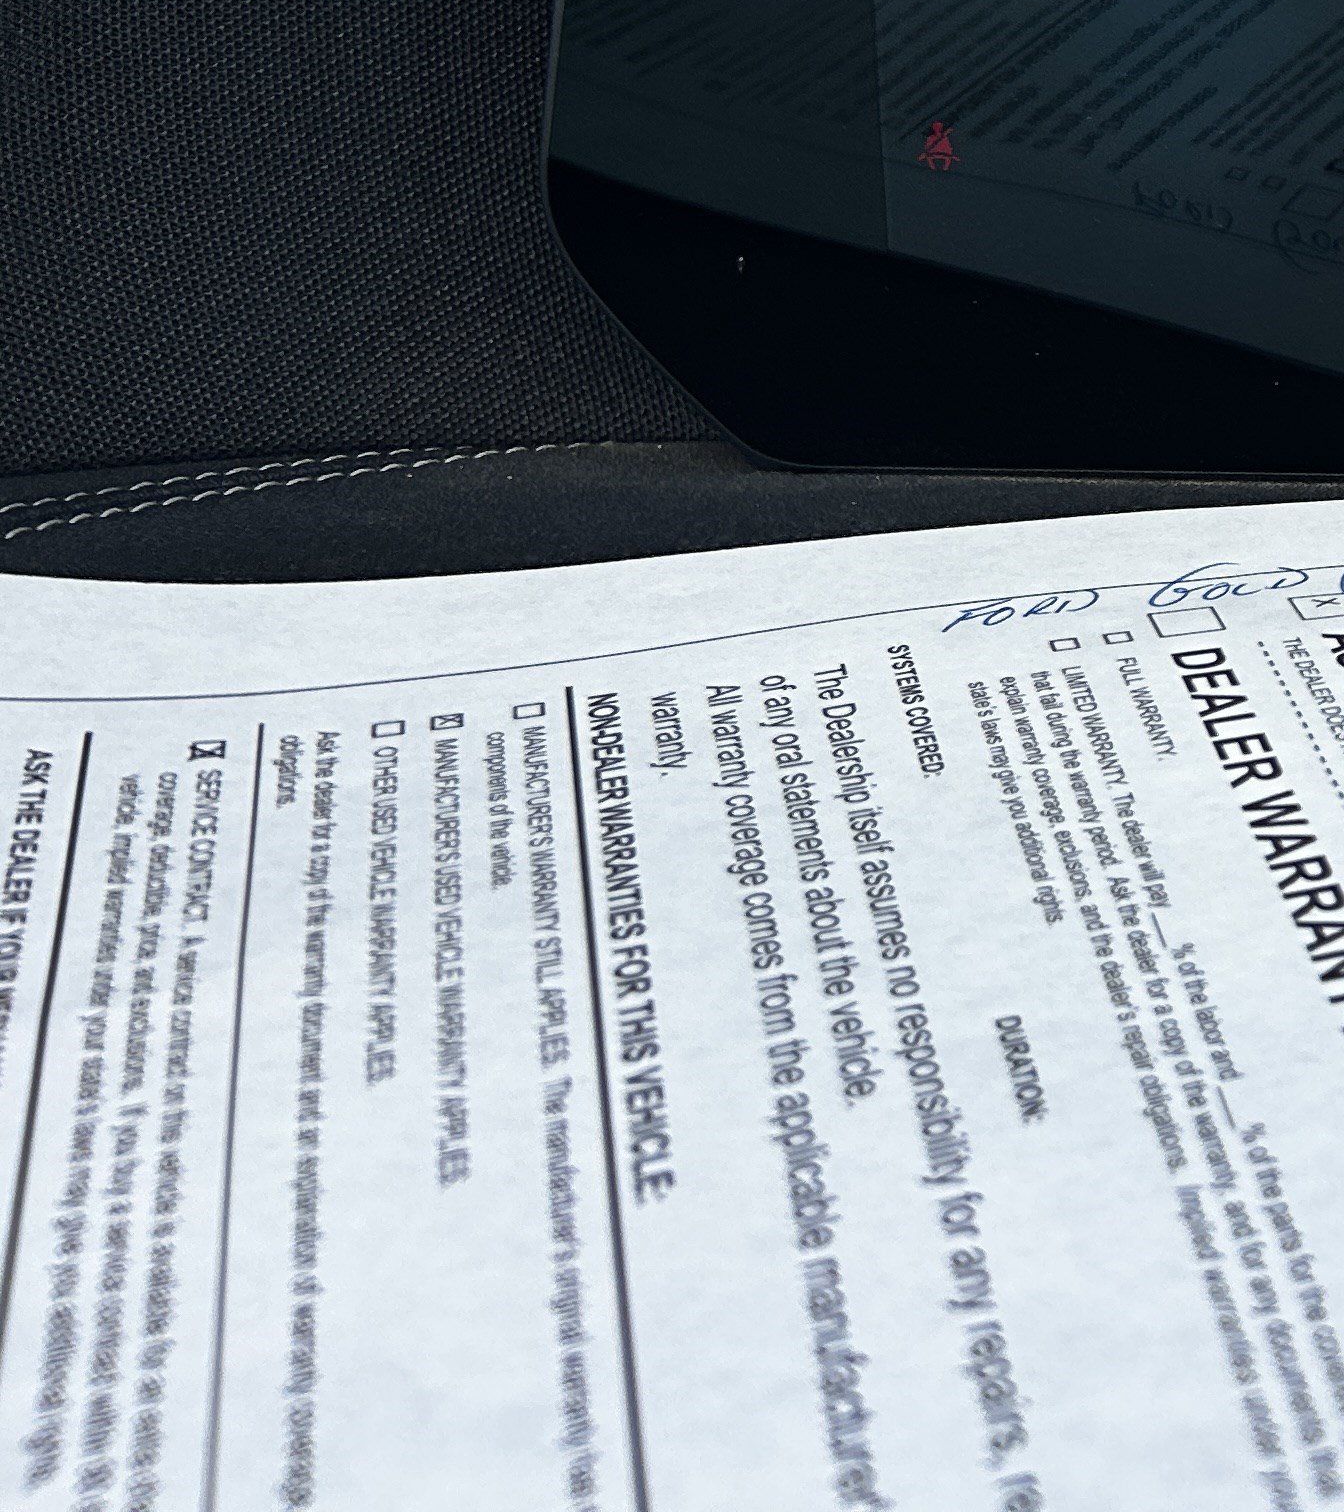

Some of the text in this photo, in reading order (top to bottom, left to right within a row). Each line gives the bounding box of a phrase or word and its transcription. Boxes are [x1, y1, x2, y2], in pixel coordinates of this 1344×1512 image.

[1281, 635, 1310, 660] THE
[812, 662, 849, 701] The
[886, 643, 945, 778] SYSTEMS COVERED:
[966, 680, 997, 718] state's
[1029, 669, 1056, 693] that
[1115, 656, 1178, 762] FULL WARRANTY.
[1293, 659, 1336, 706] DEALER
[648, 690, 693, 777] warranty.
[979, 716, 1003, 745] laws
[1044, 711, 1073, 749] during
[1169, 646, 1283, 789] DEALER
[371, 745, 399, 797] OTHER
[820, 701, 877, 804] Dealership
[987, 744, 1011, 769] may
[990, 768, 1020, 795] give
[432, 737, 462, 864] MANUFACTURER'S
[520, 724, 555, 848] MANUFACTURER'S
[997, 675, 1110, 933] explain warranty coverage, exclusions, and
[998, 795, 1028, 820] you
[1059, 664, 1172, 908] LIMITED WARRANTY. The dealer will pay
[1066, 769, 1104, 823] warranty
[0, 747, 54, 905] ASK THE DEALER
[846, 805, 895, 855] itself
[1013, 821, 1054, 883] additional
[1081, 825, 1124, 870] period.
[432, 863, 462, 906] USED
[528, 847, 561, 931] WARRANTY
[757, 674, 883, 1107] of any oral statements about the vehicle.
[858, 858, 911, 962] assumes
[532, 935, 563, 985] STILL
[586, 691, 676, 1204] NON-DEALER WARRANTIES FOR THIS VEHICLE:
[704, 684, 840, 1251] All warranty coverage comes from the applicable
[885, 964, 921, 998] no
[893, 1002, 970, 1186] responsibility
[993, 1014, 1048, 1124] DURATION:
[937, 1190, 984, 1236] for
[945, 1246, 994, 1312] any
